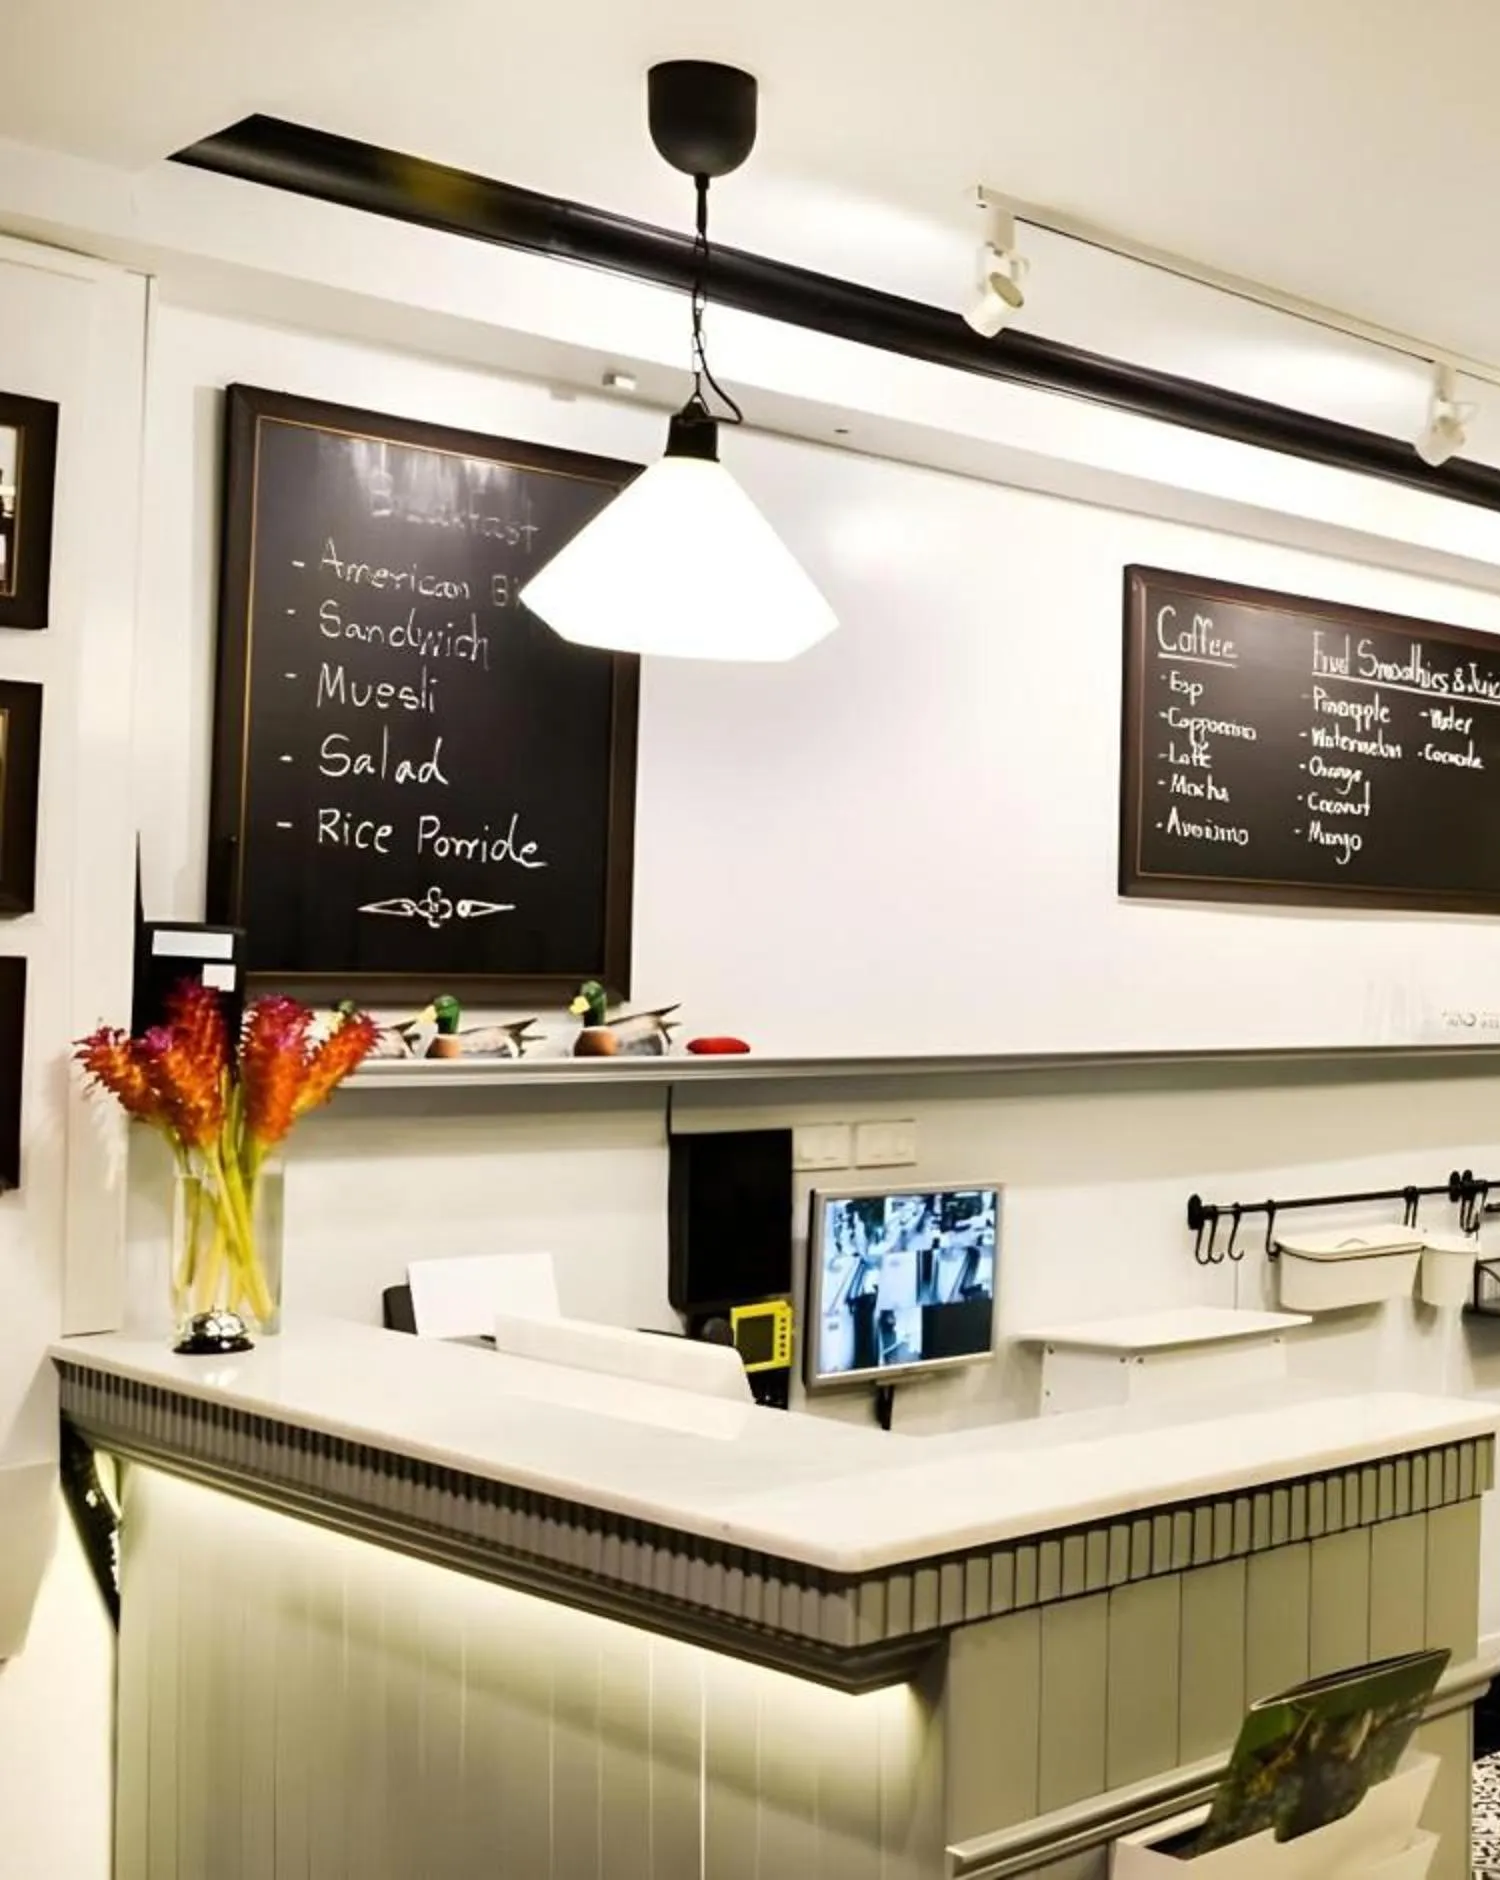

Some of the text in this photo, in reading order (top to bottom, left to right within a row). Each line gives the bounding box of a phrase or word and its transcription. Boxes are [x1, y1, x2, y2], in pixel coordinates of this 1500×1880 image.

[319, 536, 470, 600] American
[318, 599, 490, 671] Sandwich
[1157, 605, 1239, 658] Coffee
[317, 661, 439, 714] Muesli
[318, 725, 450, 786] Salad
[318, 808, 394, 854] Rice
